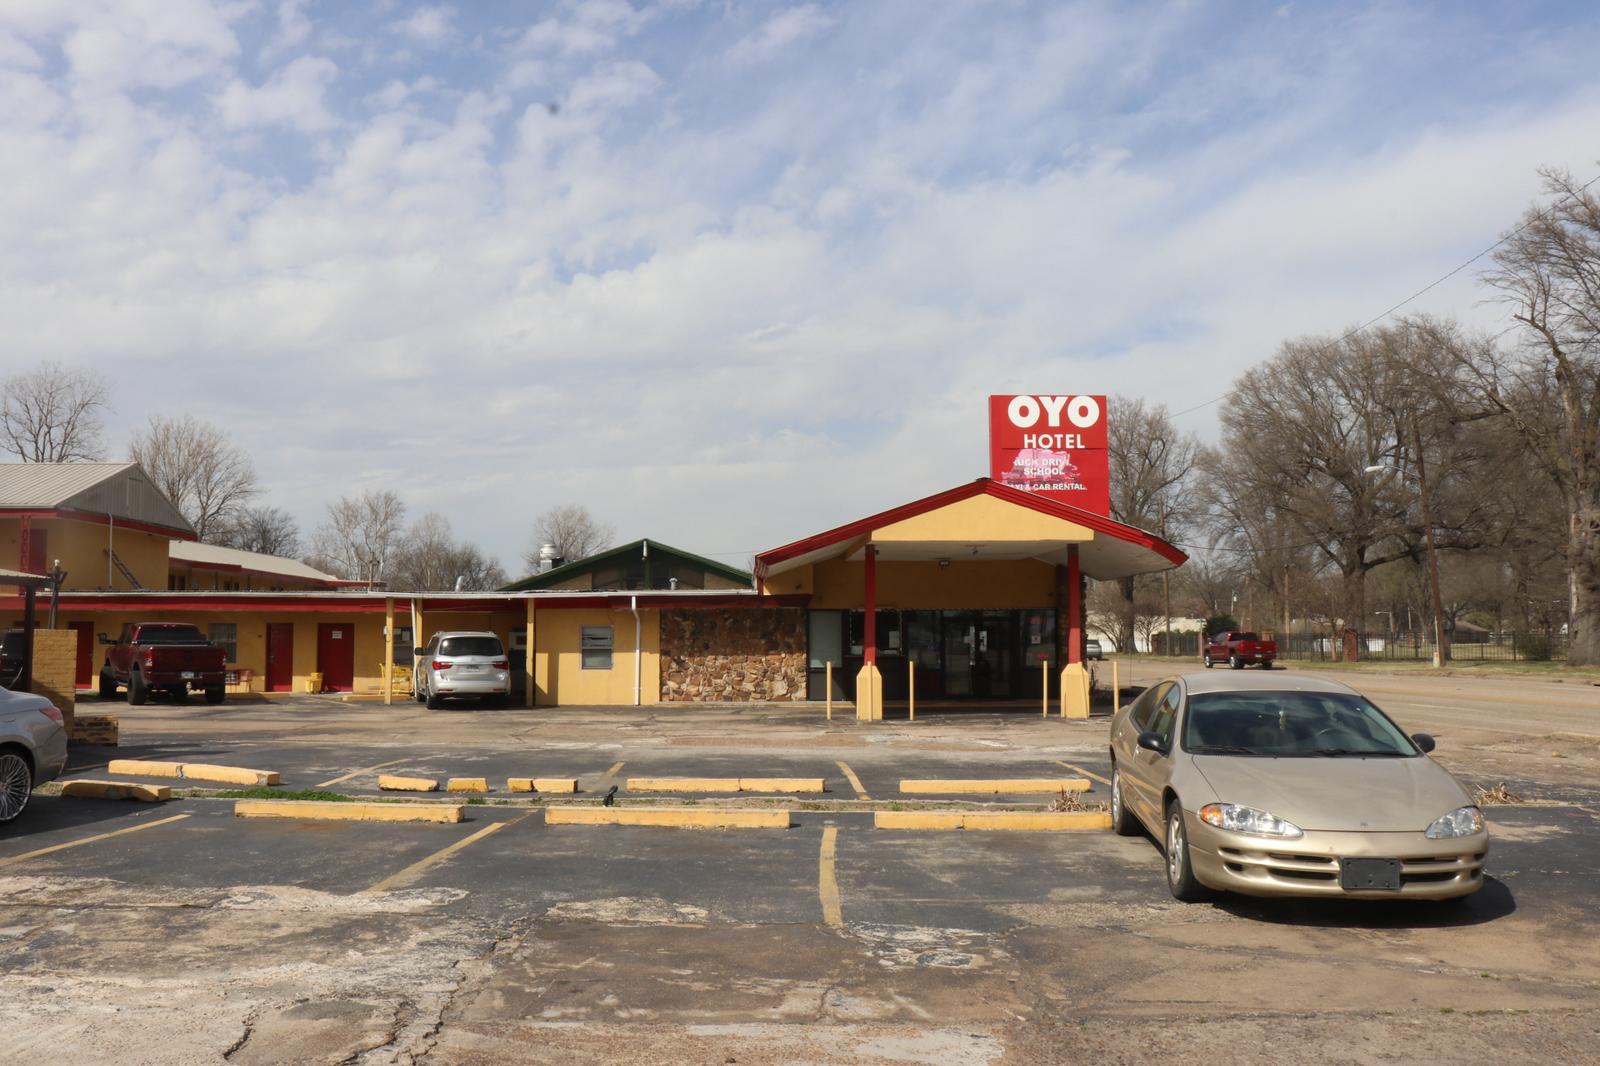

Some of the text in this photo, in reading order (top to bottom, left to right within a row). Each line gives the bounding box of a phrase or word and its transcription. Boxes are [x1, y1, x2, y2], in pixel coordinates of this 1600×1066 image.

[1008, 395, 1100, 428] OYO
[1023, 434, 1086, 449] HOTEL
[1023, 467, 1065, 475] SCHOOL
[1033, 483, 1051, 491] CAR
[1052, 483, 1086, 491] RENTAL
